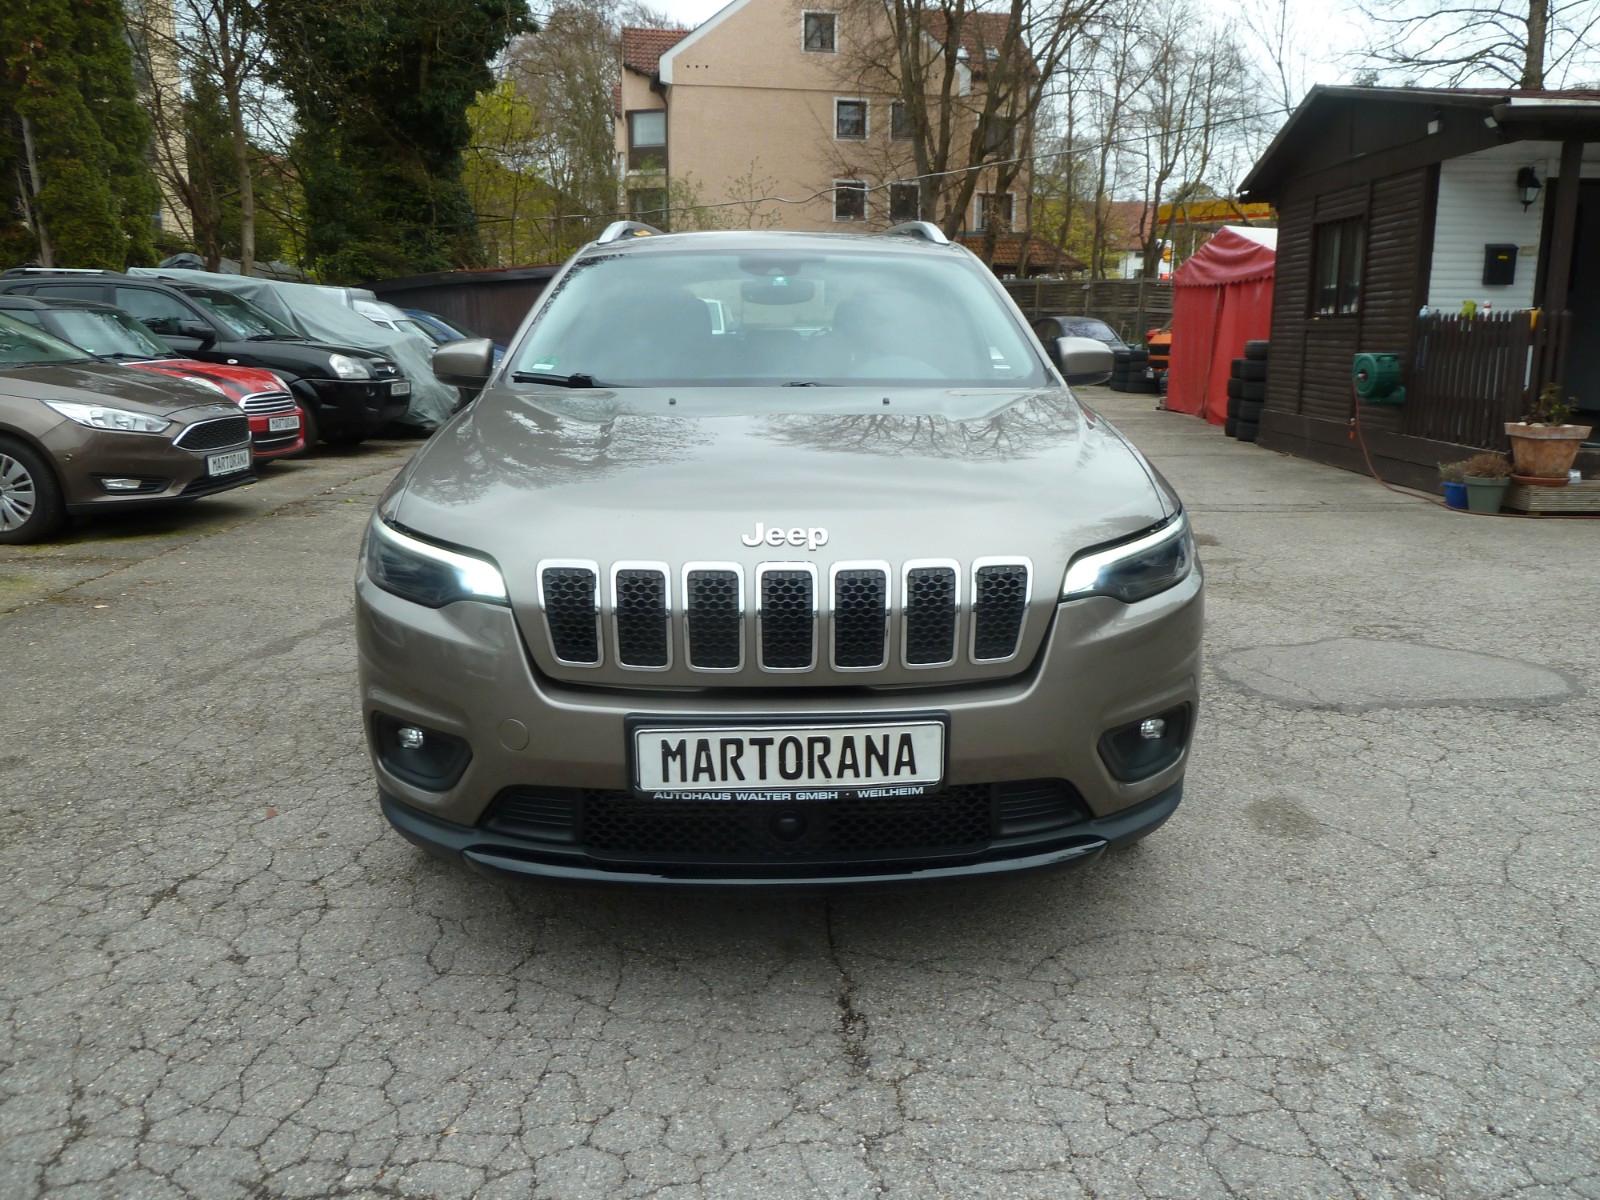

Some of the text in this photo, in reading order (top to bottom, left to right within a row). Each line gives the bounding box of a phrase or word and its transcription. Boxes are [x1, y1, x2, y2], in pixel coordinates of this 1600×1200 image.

[271, 416, 298, 429] MARTORANA
[212, 451, 248, 473] MARTORANA
[741, 522, 829, 551] Jeep
[661, 733, 917, 783] MARTORANA
[653, 787, 924, 801] AUTOHAUS WALTER GMBH WEILHEIM
